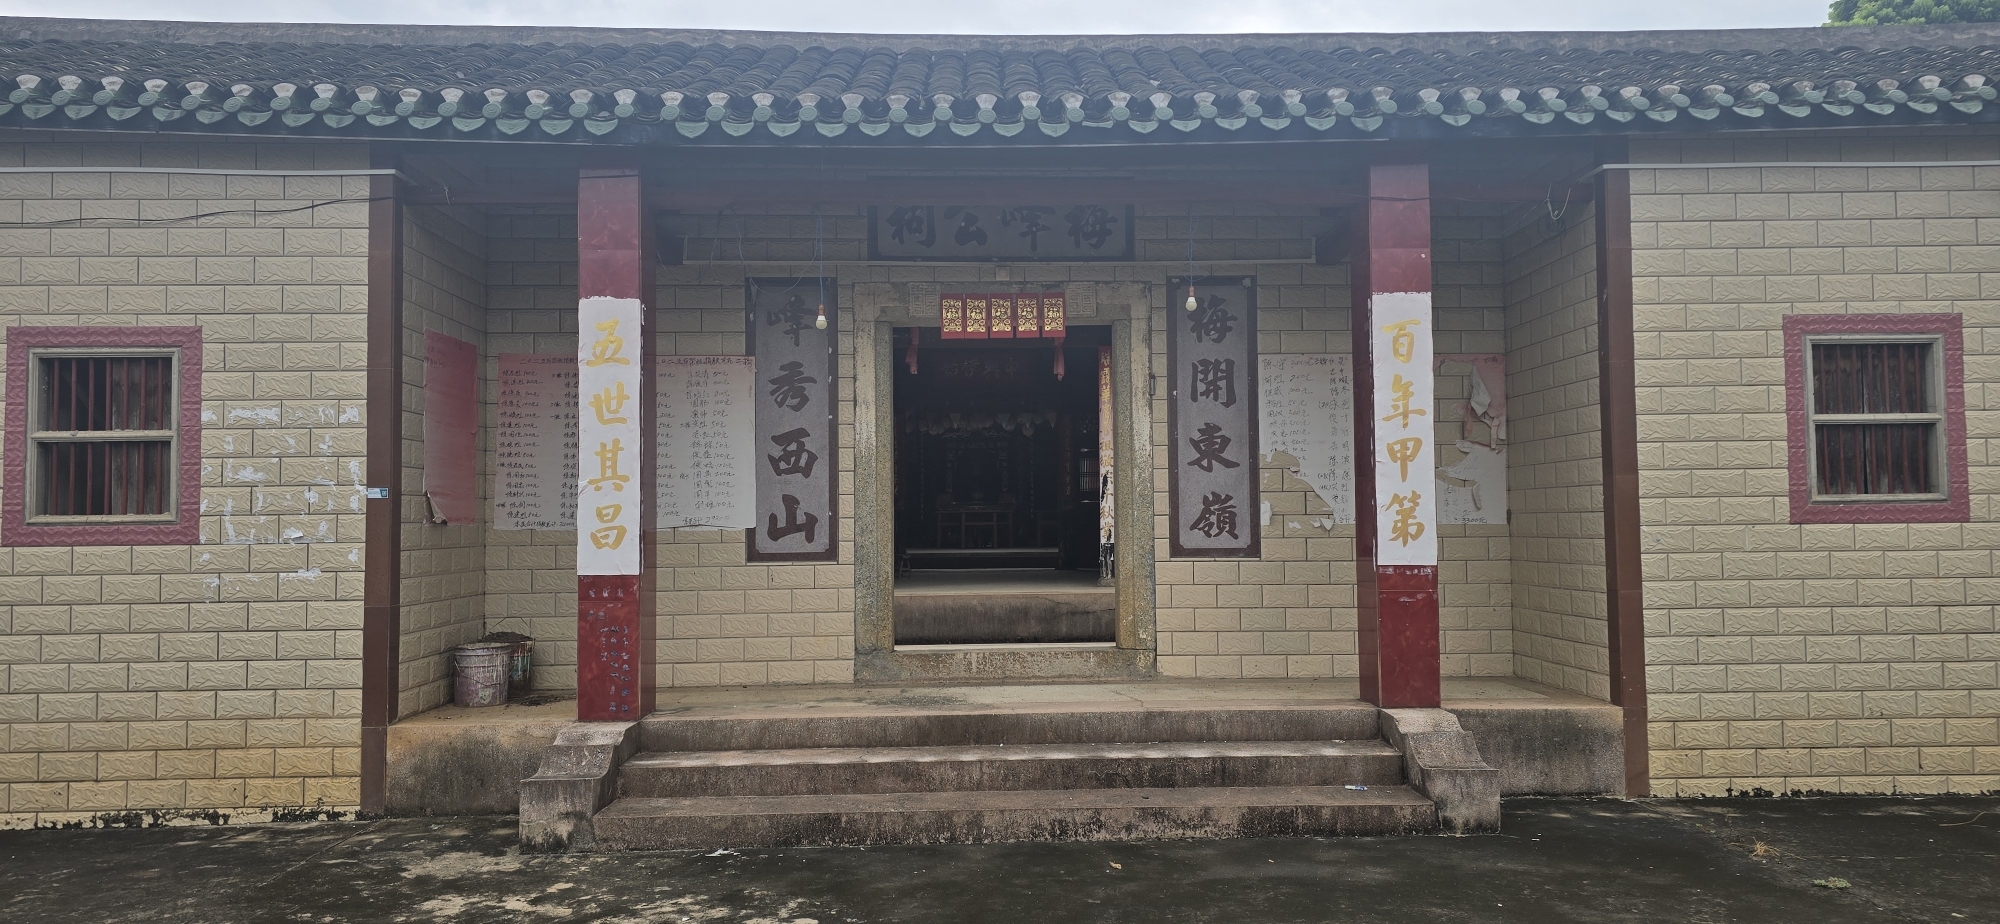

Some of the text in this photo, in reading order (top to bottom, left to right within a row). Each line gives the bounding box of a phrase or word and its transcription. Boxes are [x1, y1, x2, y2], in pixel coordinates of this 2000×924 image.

[586, 318, 631, 551] 五世其昌
[766, 296, 819, 544] 峰秀西山
[1186, 294, 1241, 540] 梅開東嶺
[1381, 319, 1427, 548] 百年甲第
